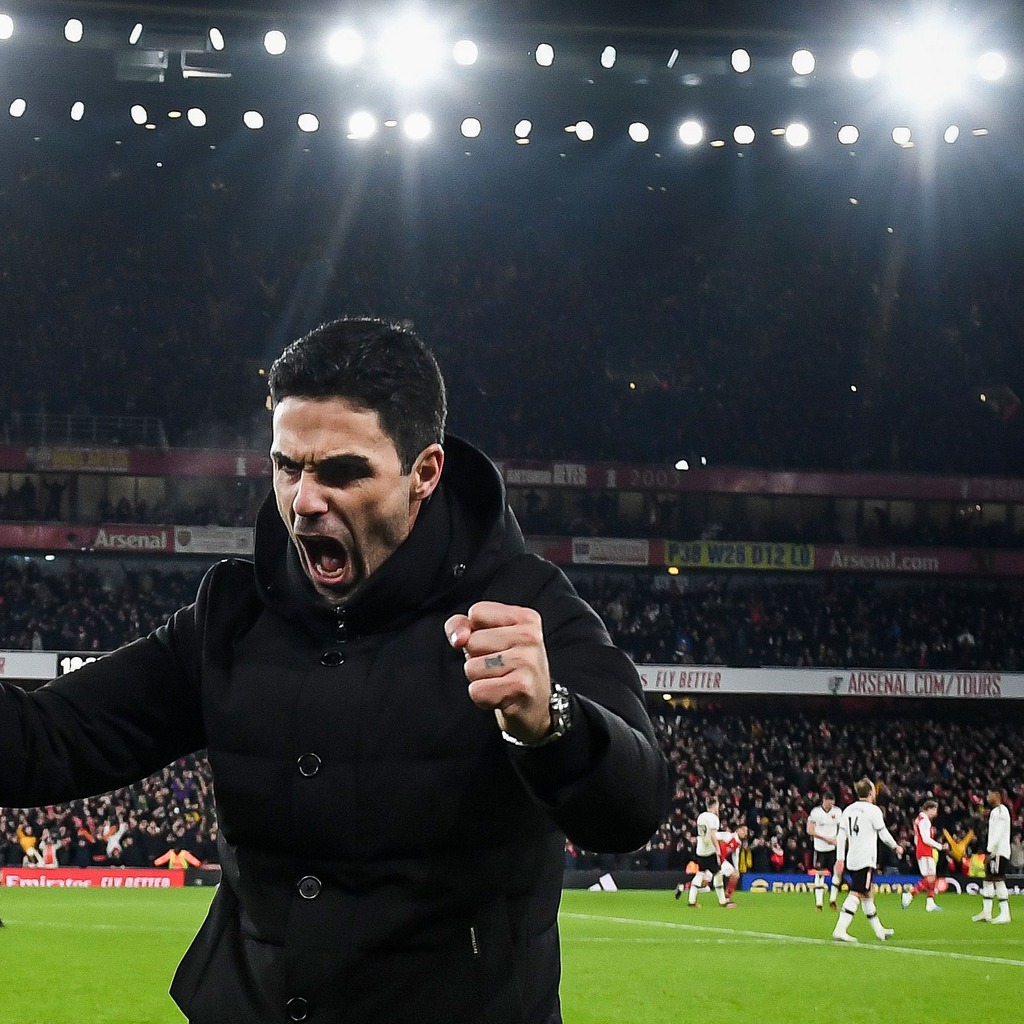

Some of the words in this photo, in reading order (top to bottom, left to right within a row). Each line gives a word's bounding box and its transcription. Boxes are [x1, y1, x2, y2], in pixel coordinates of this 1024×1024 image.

[93, 529, 167, 549] Arsenal
[831, 550, 939, 571] Arsenal.com
[656, 671, 676, 688] FLY
[679, 671, 722, 689] BETTER
[848, 672, 1002, 696] ARSENAL.COM/TOURS
[5, 875, 92, 888] Emirates
